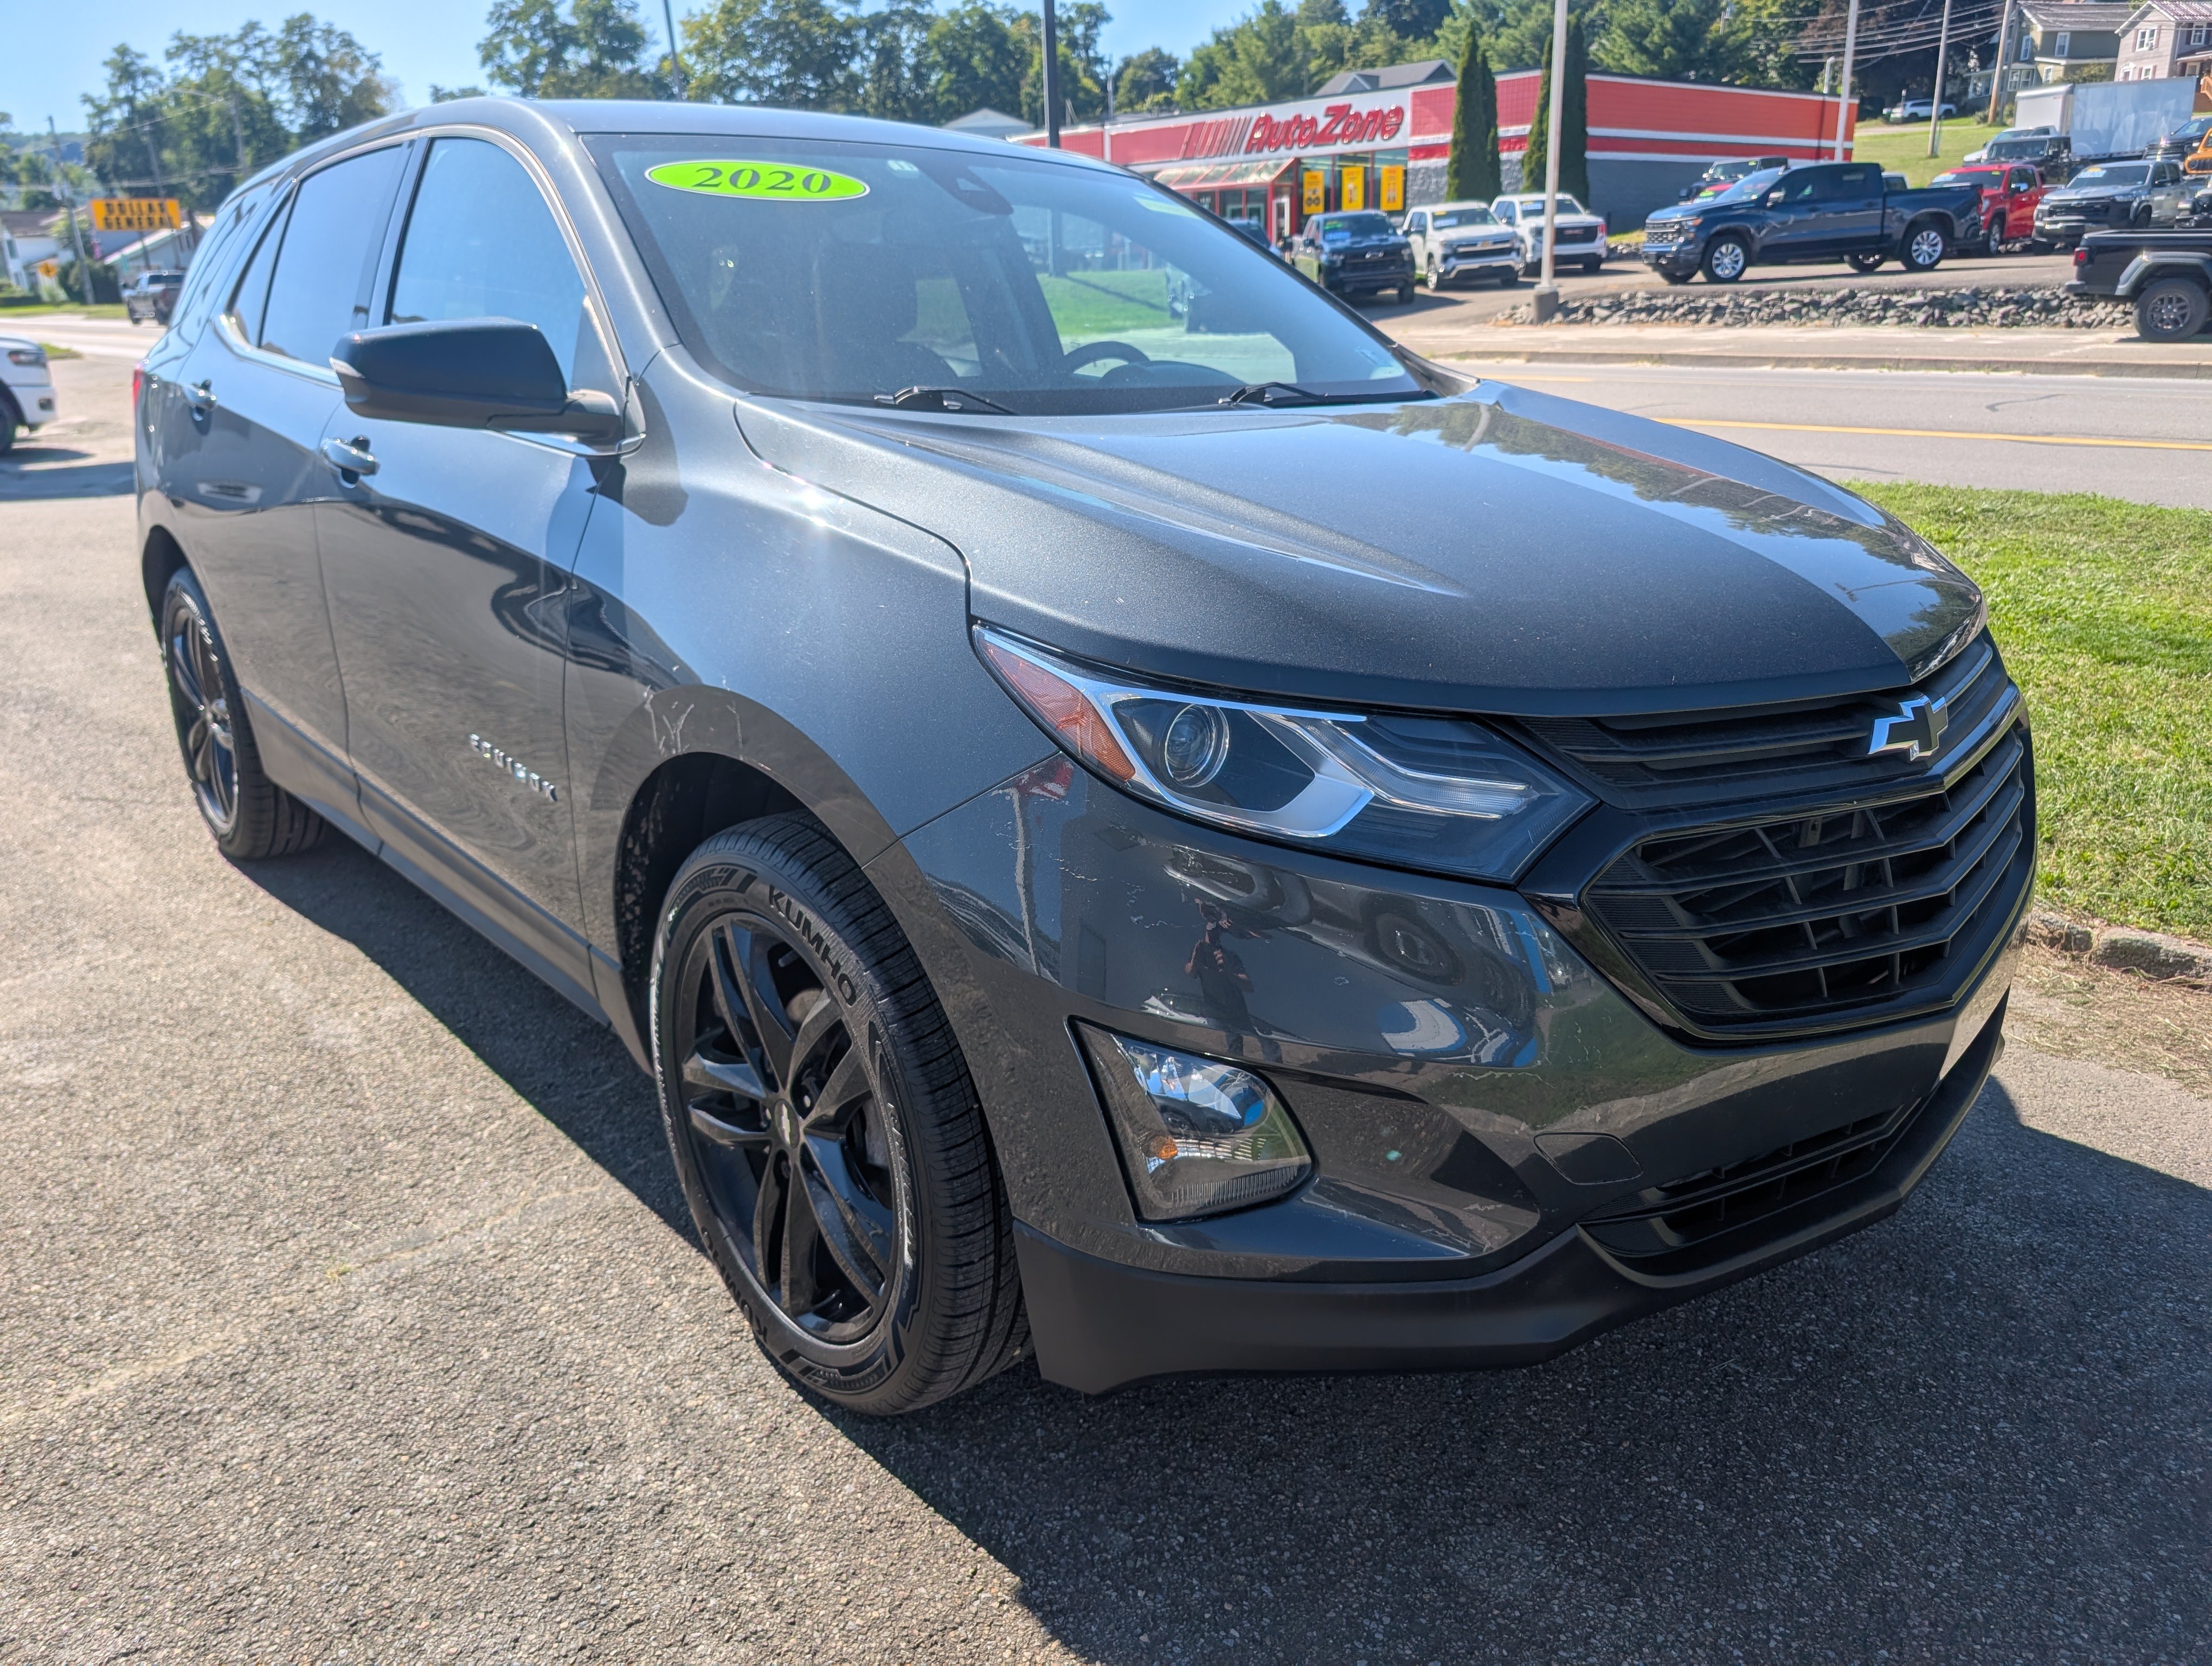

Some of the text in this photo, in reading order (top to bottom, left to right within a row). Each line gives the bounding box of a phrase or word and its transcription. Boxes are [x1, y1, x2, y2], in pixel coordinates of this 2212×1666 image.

[1244, 103, 1404, 153] AutoZone
[692, 167, 831, 193] 2020
[469, 734, 557, 802] EQUINOX
[769, 884, 857, 1007] KUMHO
